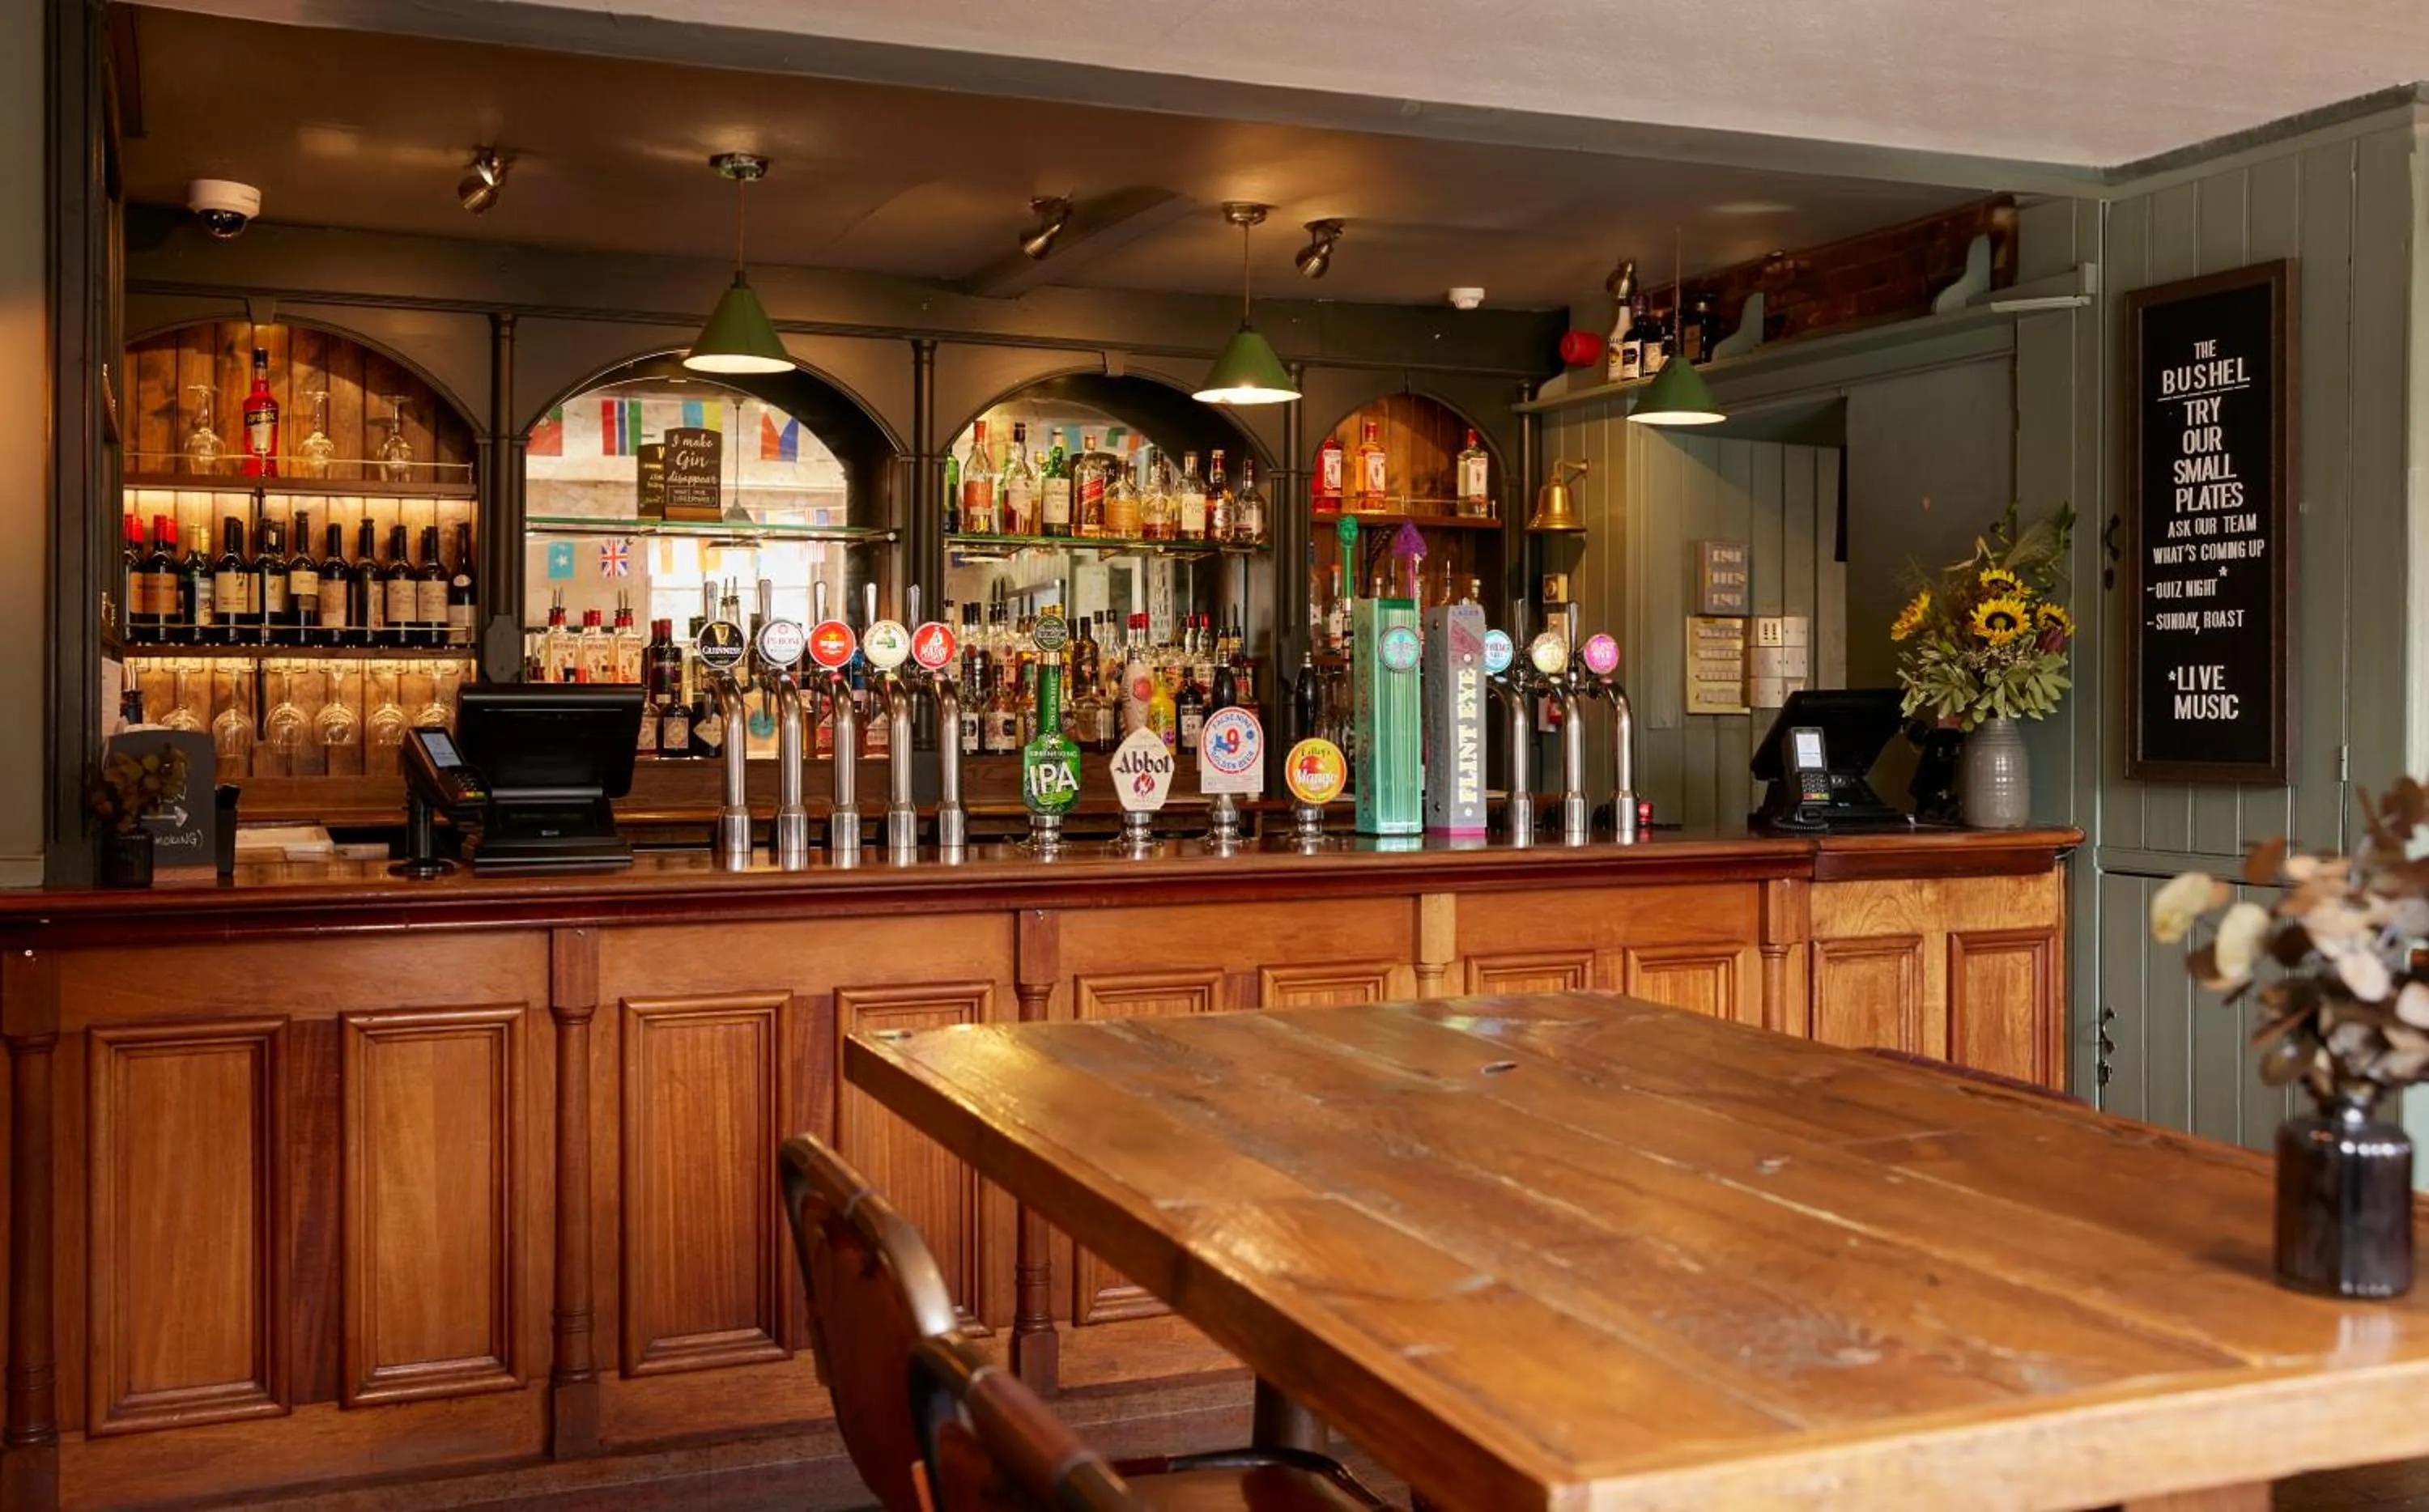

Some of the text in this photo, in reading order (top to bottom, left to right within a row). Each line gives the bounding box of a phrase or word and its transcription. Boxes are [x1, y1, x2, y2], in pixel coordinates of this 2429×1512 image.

[2193, 339, 2217, 360] THE
[2162, 356, 2251, 395] BUSHEL
[2183, 396, 2222, 427] TRY
[683, 433, 713, 447] make
[2182, 425, 2223, 455] OUR
[675, 450, 709, 469] Gin
[2173, 452, 2237, 485] SMALL
[2176, 482, 2244, 513] PLATES
[2167, 512, 2257, 538] ASK OUR TEAM
[2153, 538, 2265, 564] WHAT'S COMING UP
[2185, 577, 2218, 597] NIGHT
[2203, 609, 2245, 629] ROAST
[2177, 665, 2226, 691] LIVE
[2174, 694, 2239, 720] MUSIC
[1457, 668, 1478, 803] FLINT EYE
[1114, 750, 1172, 774] Abbot
[1029, 761, 1079, 796] IPA
